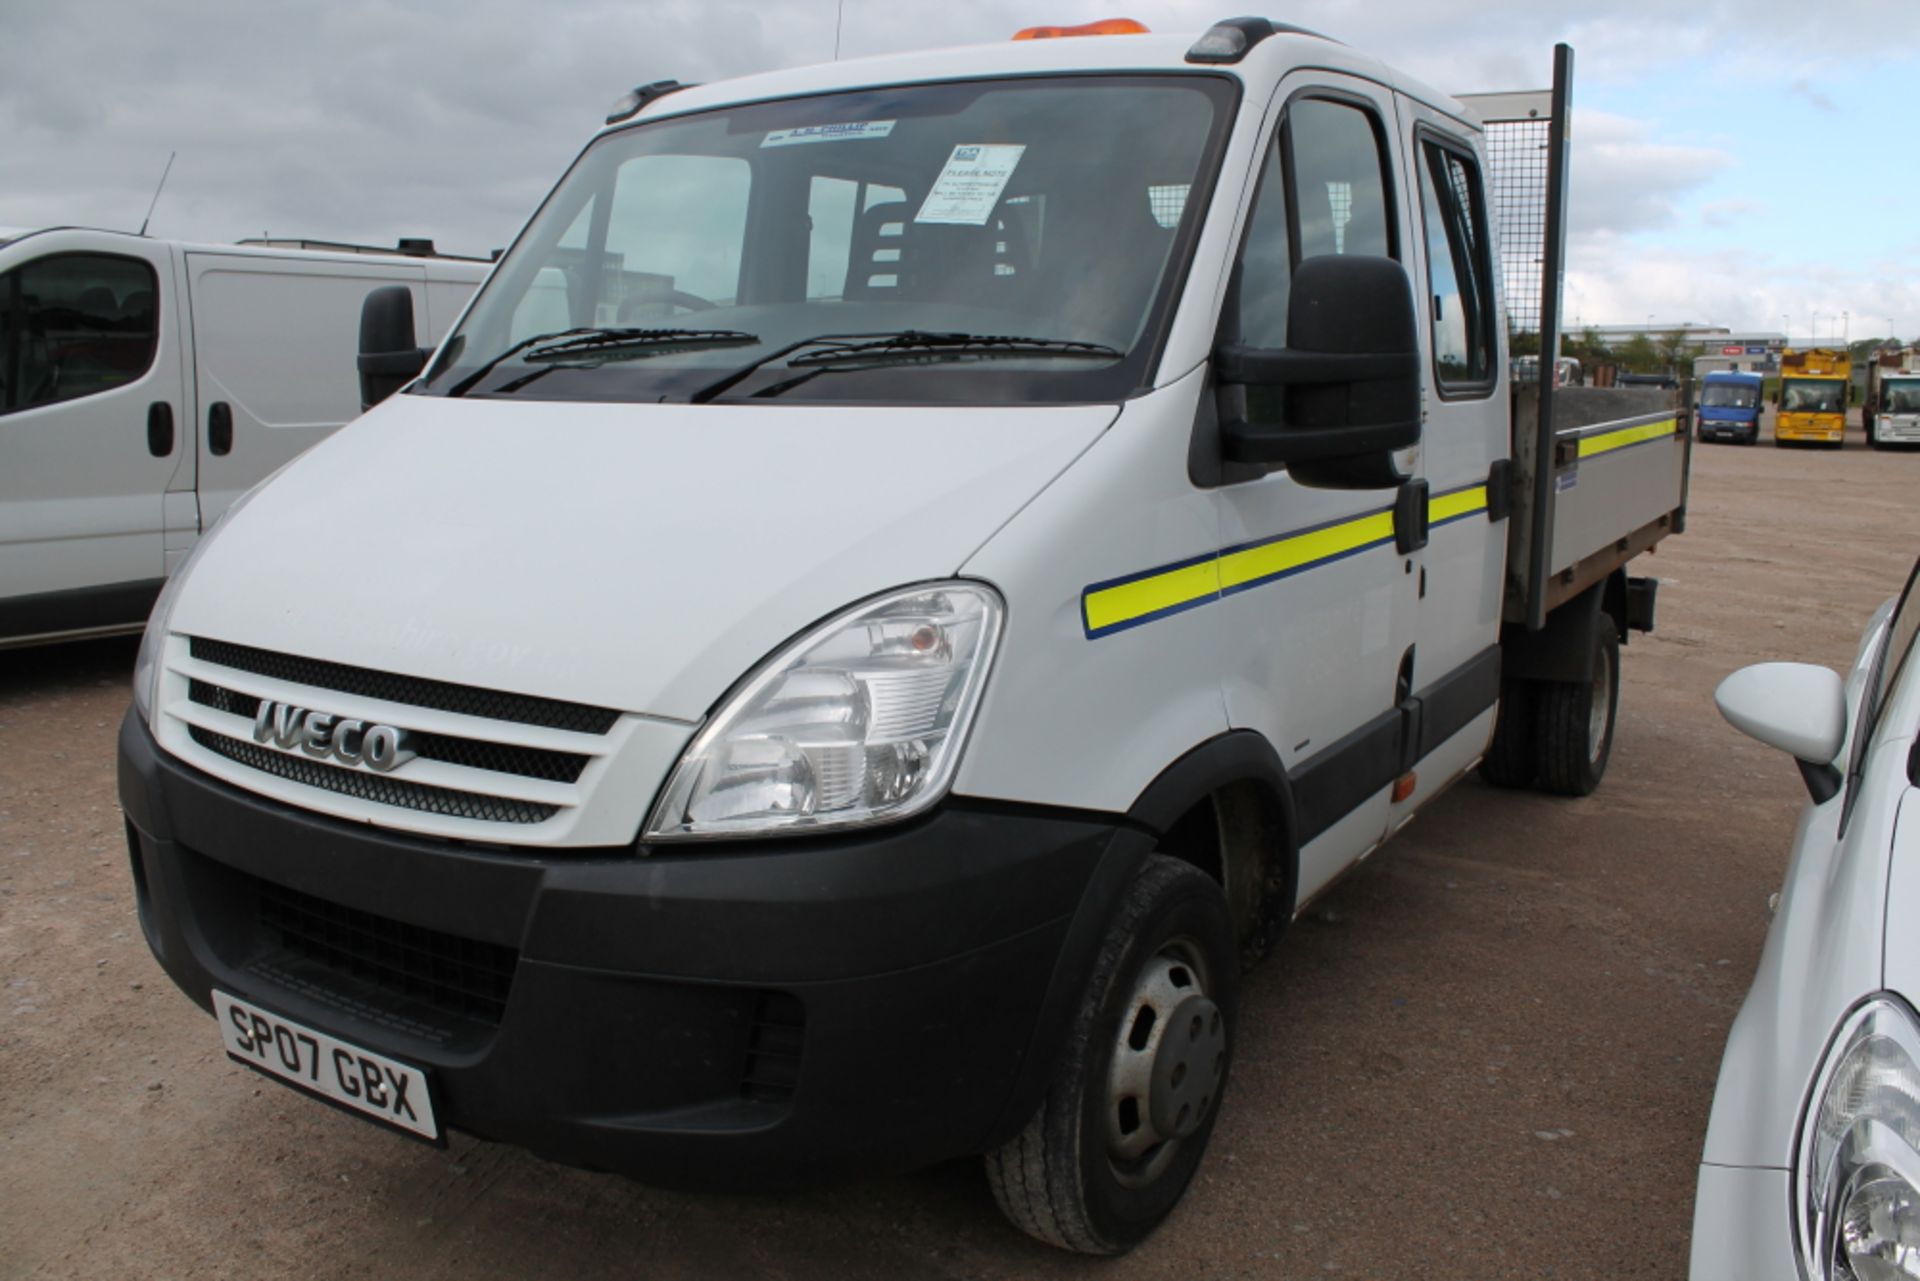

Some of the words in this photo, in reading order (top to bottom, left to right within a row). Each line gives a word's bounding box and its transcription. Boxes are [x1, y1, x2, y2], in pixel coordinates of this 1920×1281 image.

[253, 700, 399, 772] IVECO
[229, 1004, 319, 1082] SP07
[332, 1048, 417, 1122] GBX
